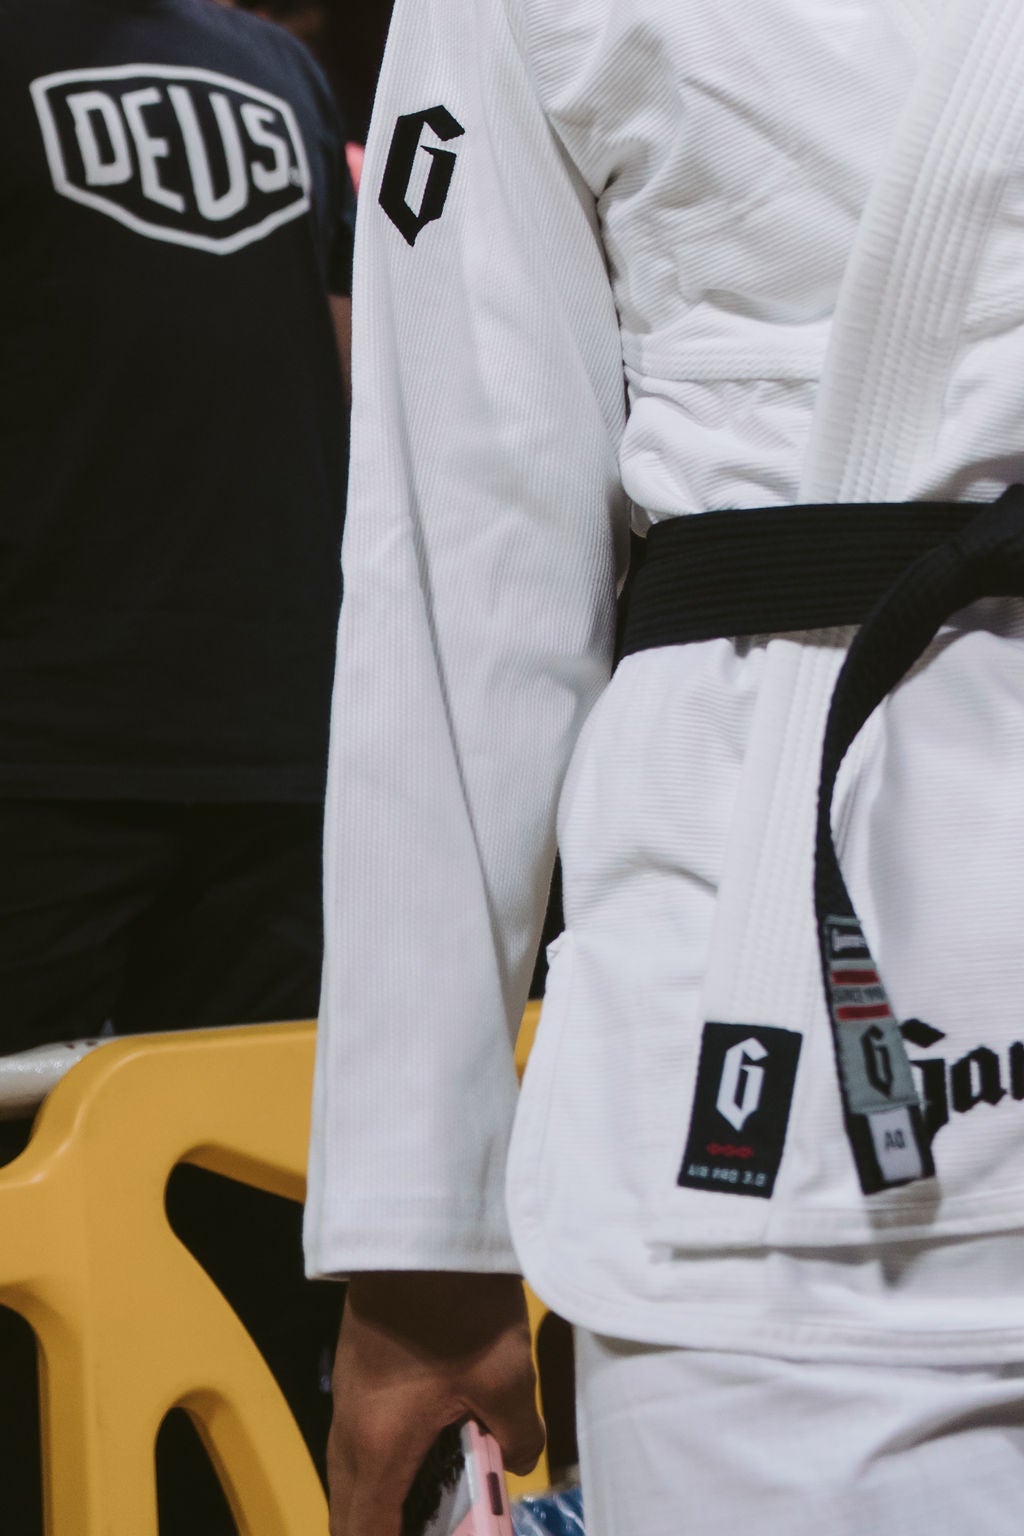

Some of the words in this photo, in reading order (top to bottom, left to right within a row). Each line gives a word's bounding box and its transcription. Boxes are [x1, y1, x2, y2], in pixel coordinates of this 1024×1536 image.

[66, 75, 290, 221] DEUS
[379, 105, 465, 247] G
[715, 1036, 769, 1133] G
[861, 1024, 894, 1099] G
